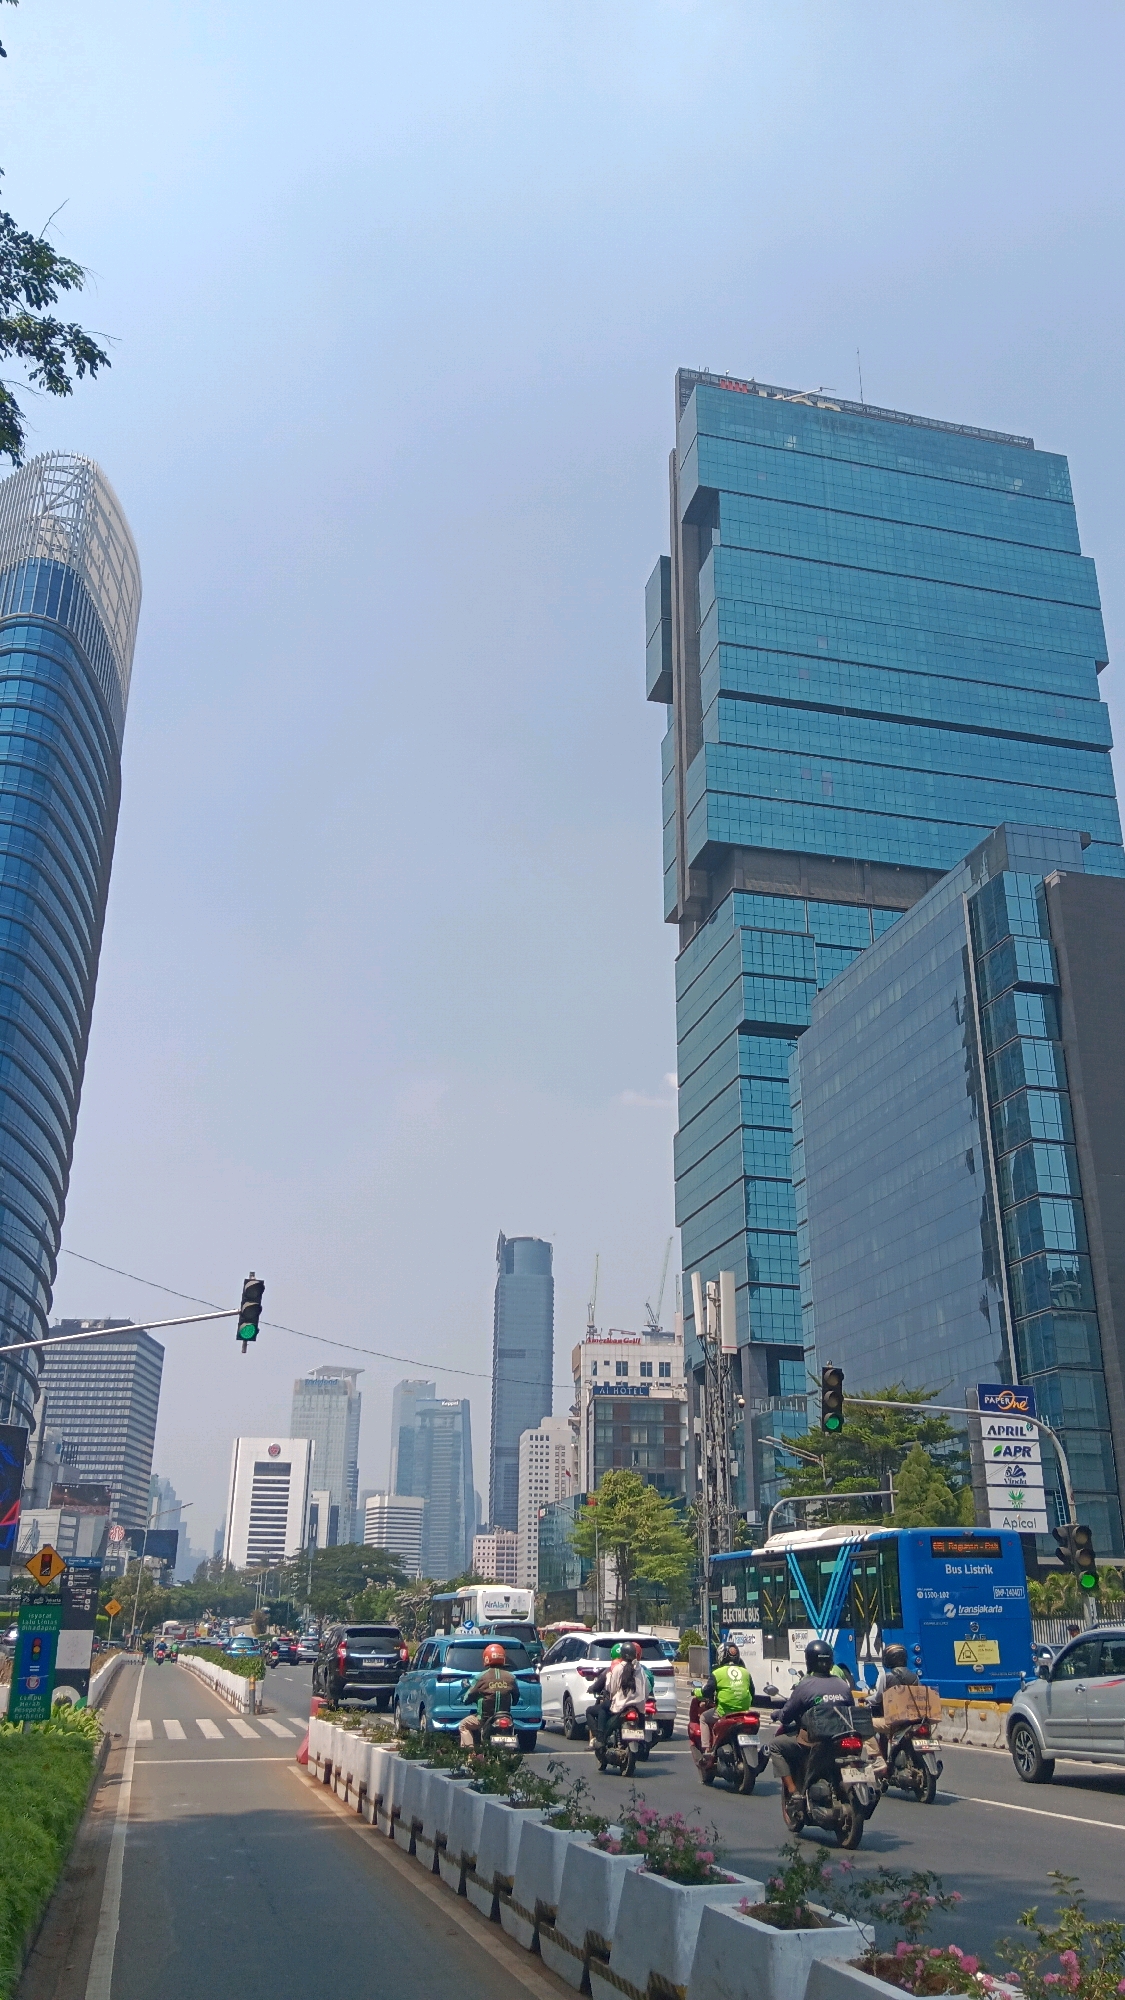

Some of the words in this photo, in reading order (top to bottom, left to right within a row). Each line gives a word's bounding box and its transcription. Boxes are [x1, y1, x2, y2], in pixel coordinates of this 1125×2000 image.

[587, 1336, 622, 1344] American
[613, 1387, 643, 1395] HOTEL
[987, 1425, 1026, 1437] APRIL
[1003, 1446, 1031, 1457] APR
[1002, 1516, 1037, 1530] Apical
[945, 1564, 962, 1574] Bus
[964, 1564, 993, 1575] Listrik
[722, 1608, 747, 1622] ELECTRIC
[748, 1607, 760, 1622] BUS
[958, 1605, 1003, 1615] transjakarta
[488, 1681, 508, 1689] Grab
[822, 1693, 845, 1703] gojek
